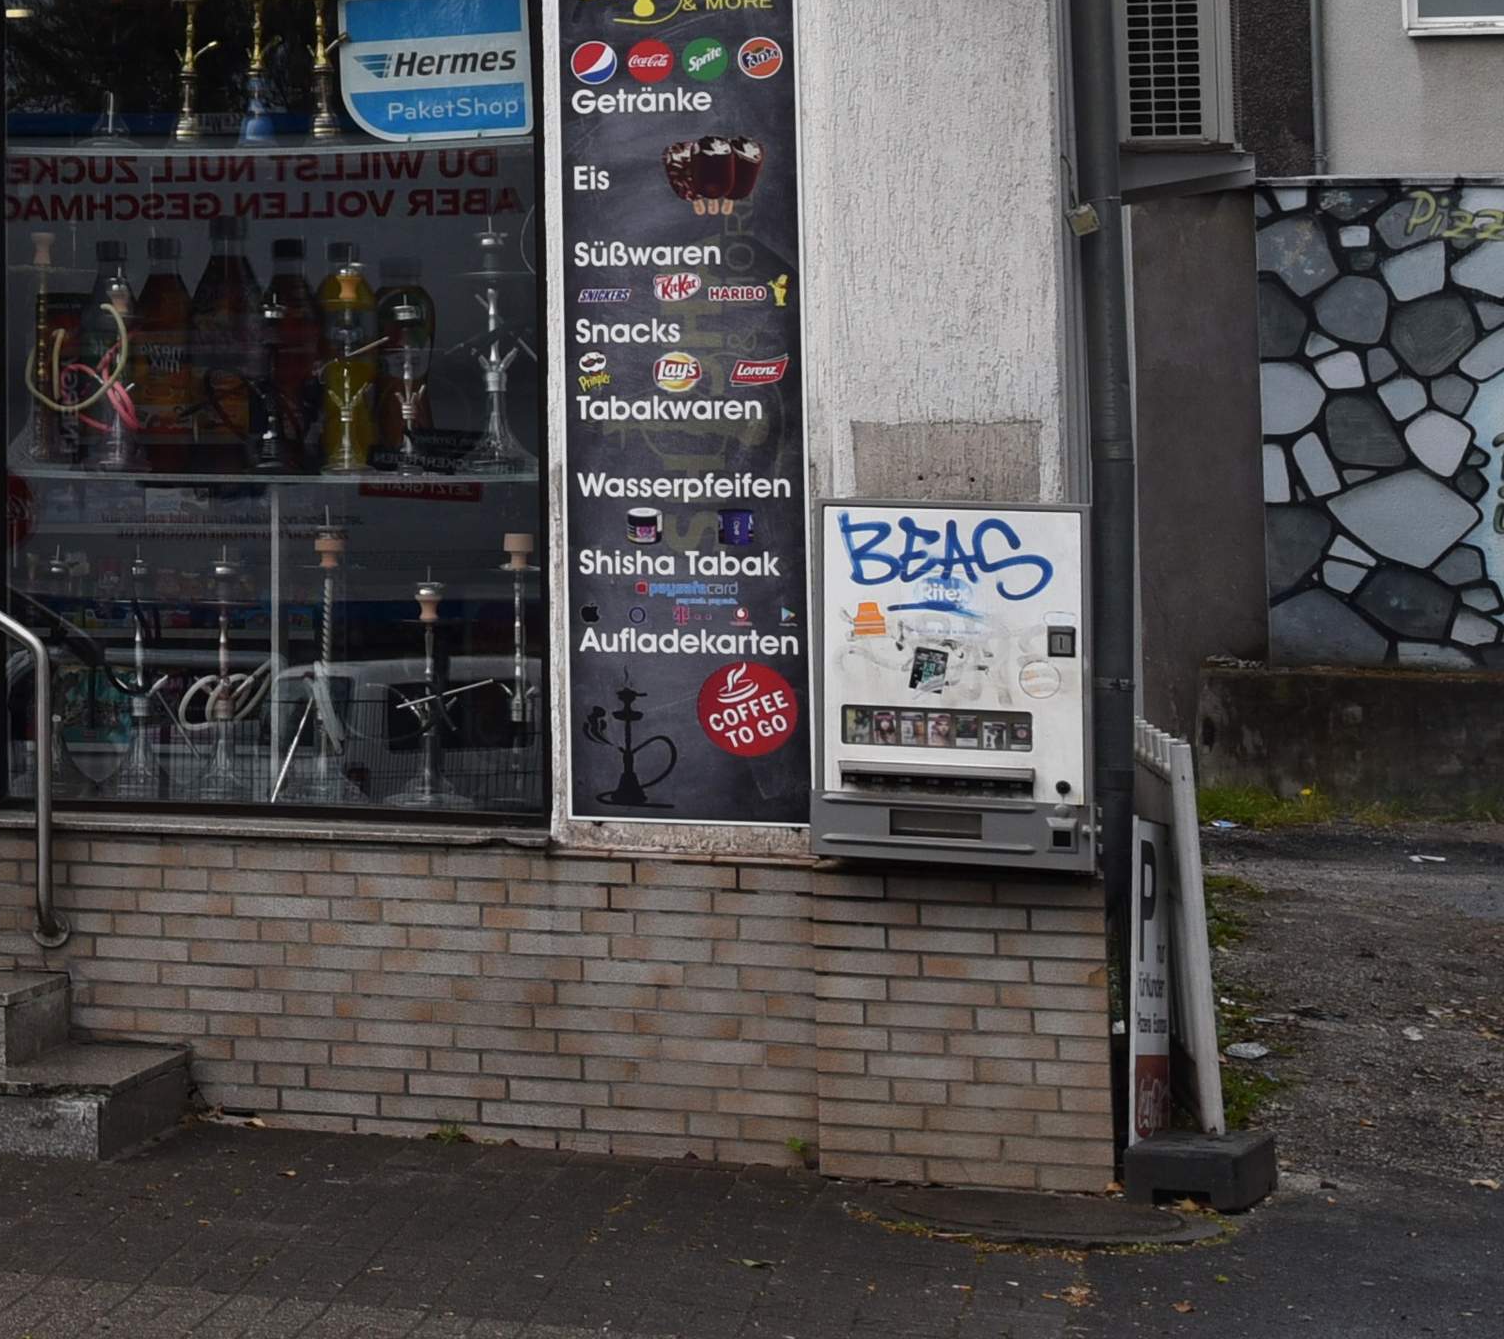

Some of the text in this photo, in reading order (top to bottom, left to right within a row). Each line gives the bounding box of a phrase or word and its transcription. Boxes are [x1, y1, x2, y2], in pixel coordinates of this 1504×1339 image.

[393, 48, 517, 79] Hermes
[688, 46, 722, 73] Sprite
[742, 47, 780, 70] Fanta
[387, 96, 520, 122] PaketShop
[571, 87, 713, 115] Getränke
[573, 166, 610, 191] Eis
[574, 241, 722, 268] Süßwaren
[580, 288, 631, 302] SNICKERS
[709, 286, 767, 301] HARIBO
[575, 317, 682, 344] Snacks
[736, 363, 780, 378] Lorenz
[577, 395, 763, 421] Tabakwaren
[577, 472, 791, 503] Wasserpfeifen
[579, 548, 781, 577] Shisha Tabak
[838, 511, 1054, 601] BEAS
[648, 581, 739, 598] paysafecard
[579, 627, 799, 656] Aufladekarten
[709, 689, 789, 733] COFFEE
[725, 716, 788, 749] TO GO
[1140, 839, 1157, 962] P
